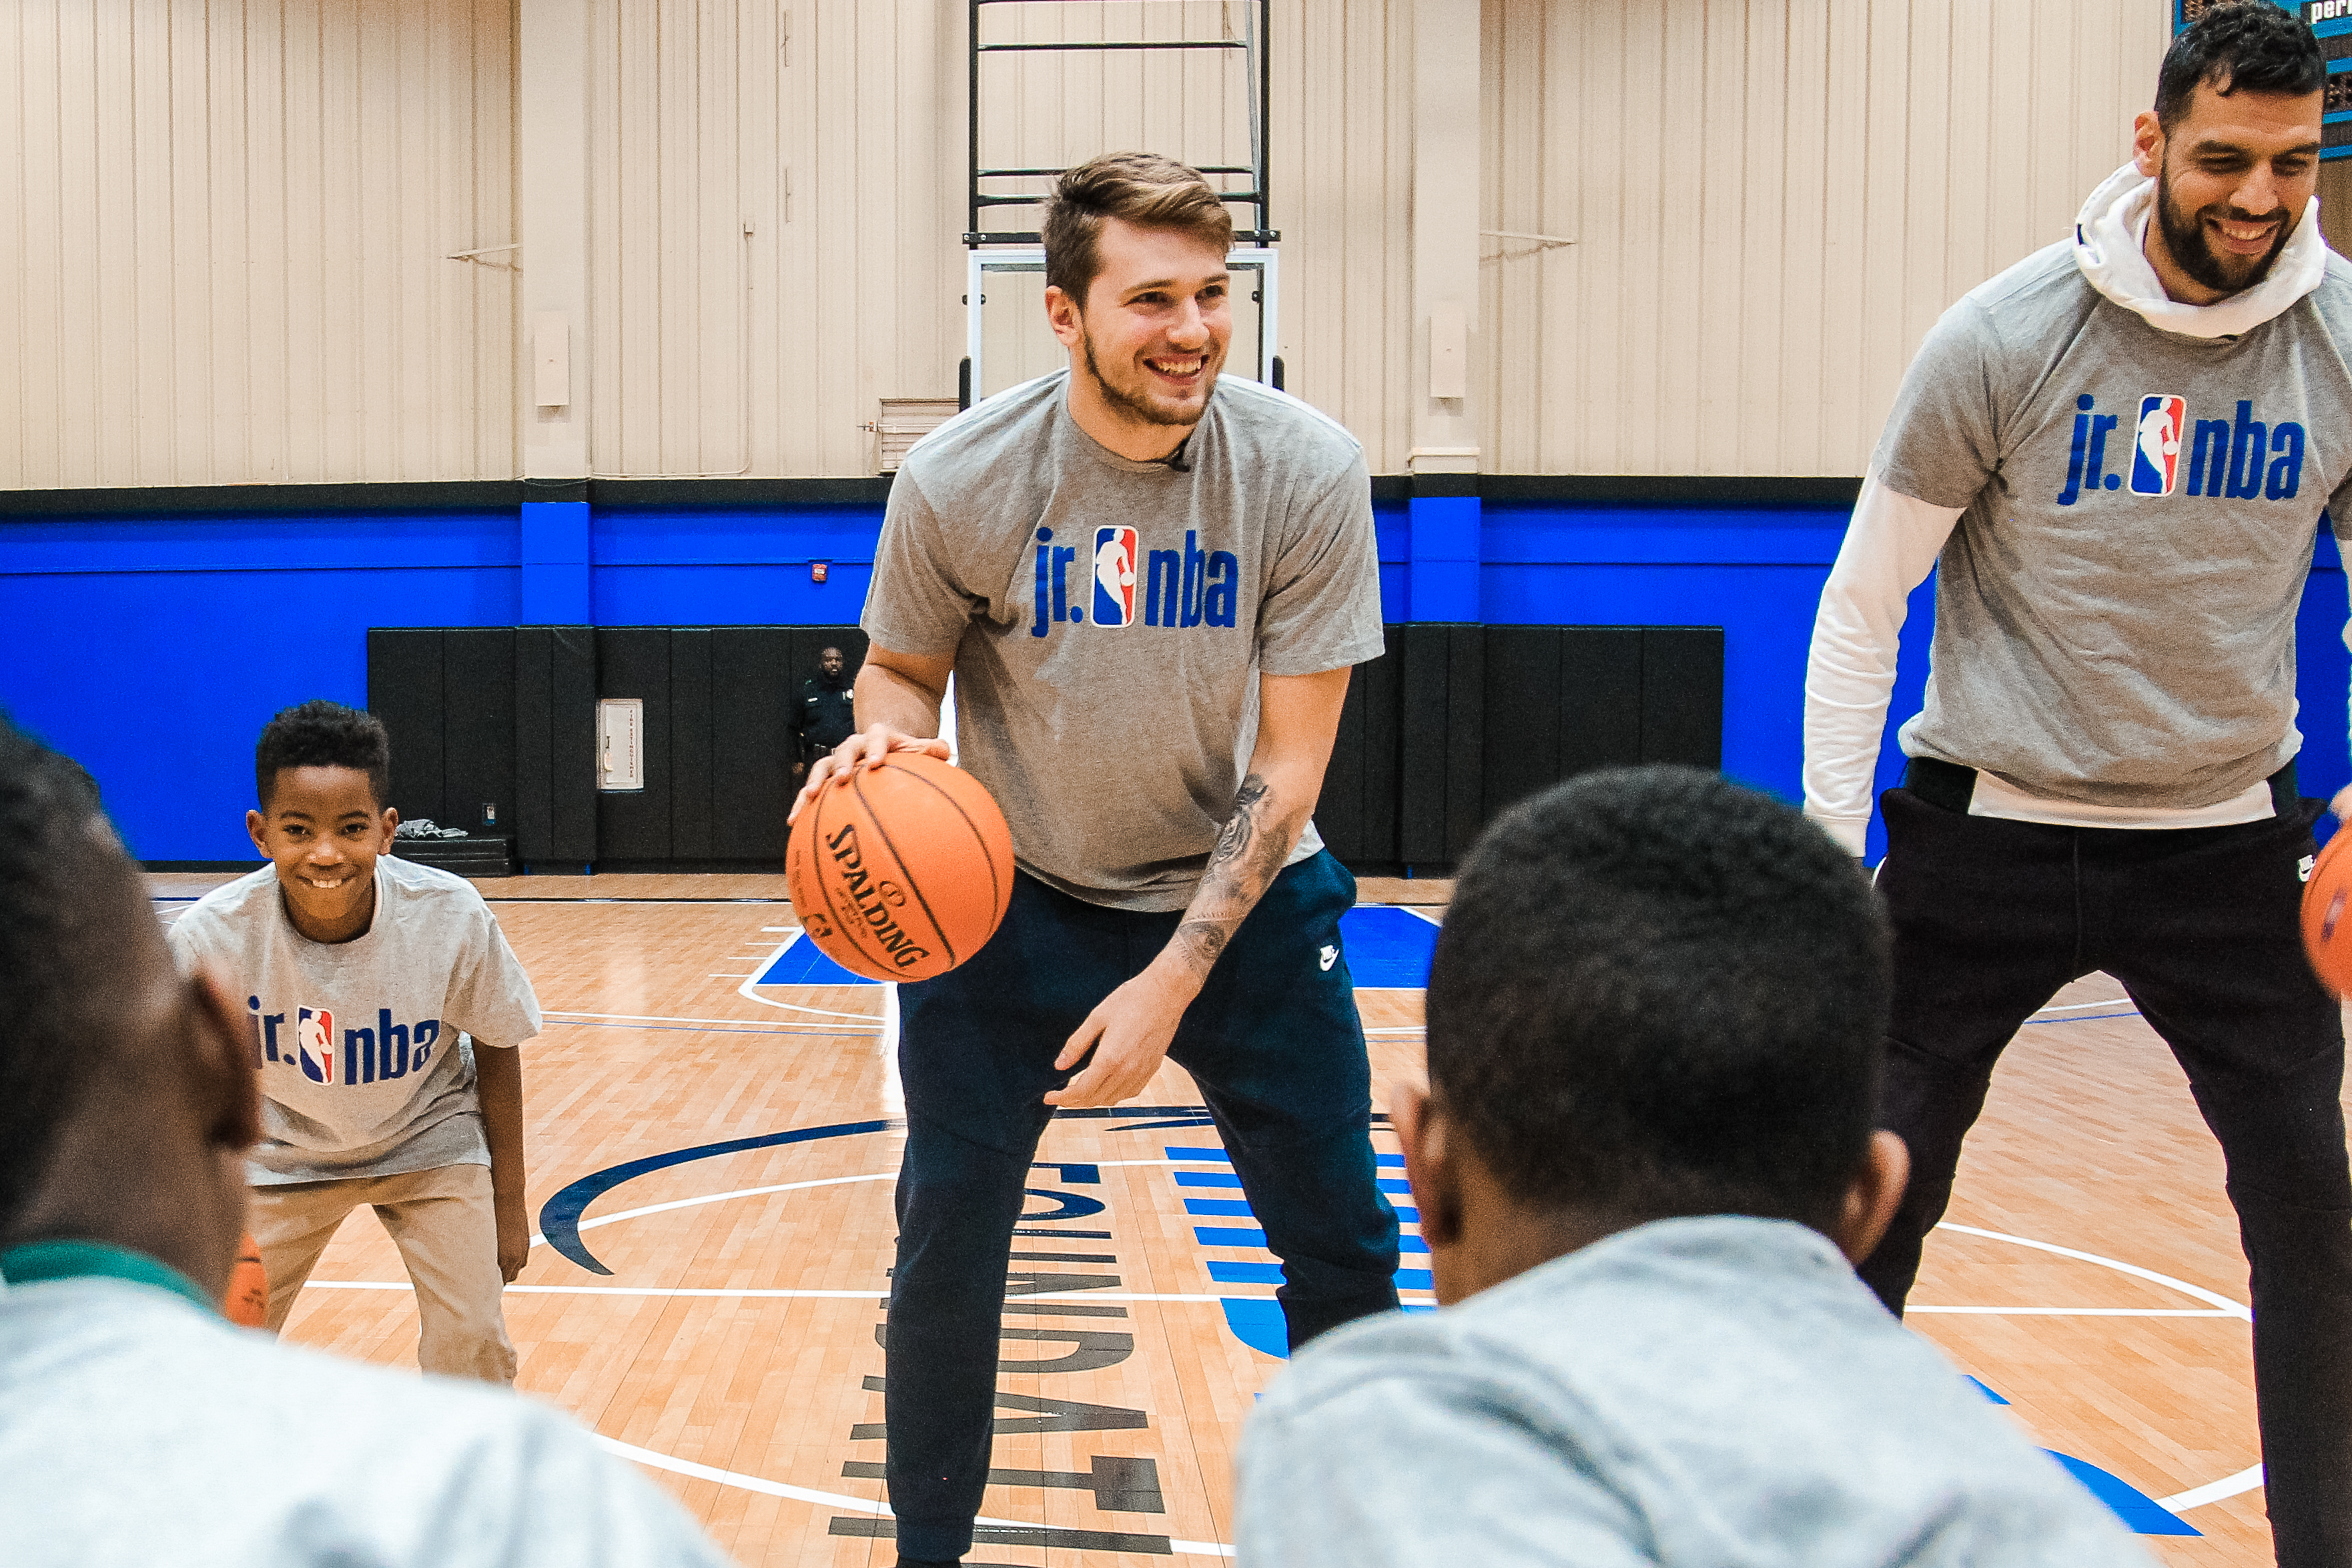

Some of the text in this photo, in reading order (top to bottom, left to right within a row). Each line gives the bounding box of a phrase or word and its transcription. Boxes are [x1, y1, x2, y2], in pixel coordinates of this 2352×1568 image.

[2057, 394, 2305, 506] jr. nba
[1031, 526, 1239, 638] jr. nba
[825, 824, 930, 967] SPALDING
[344, 1008, 440, 1086] nba
